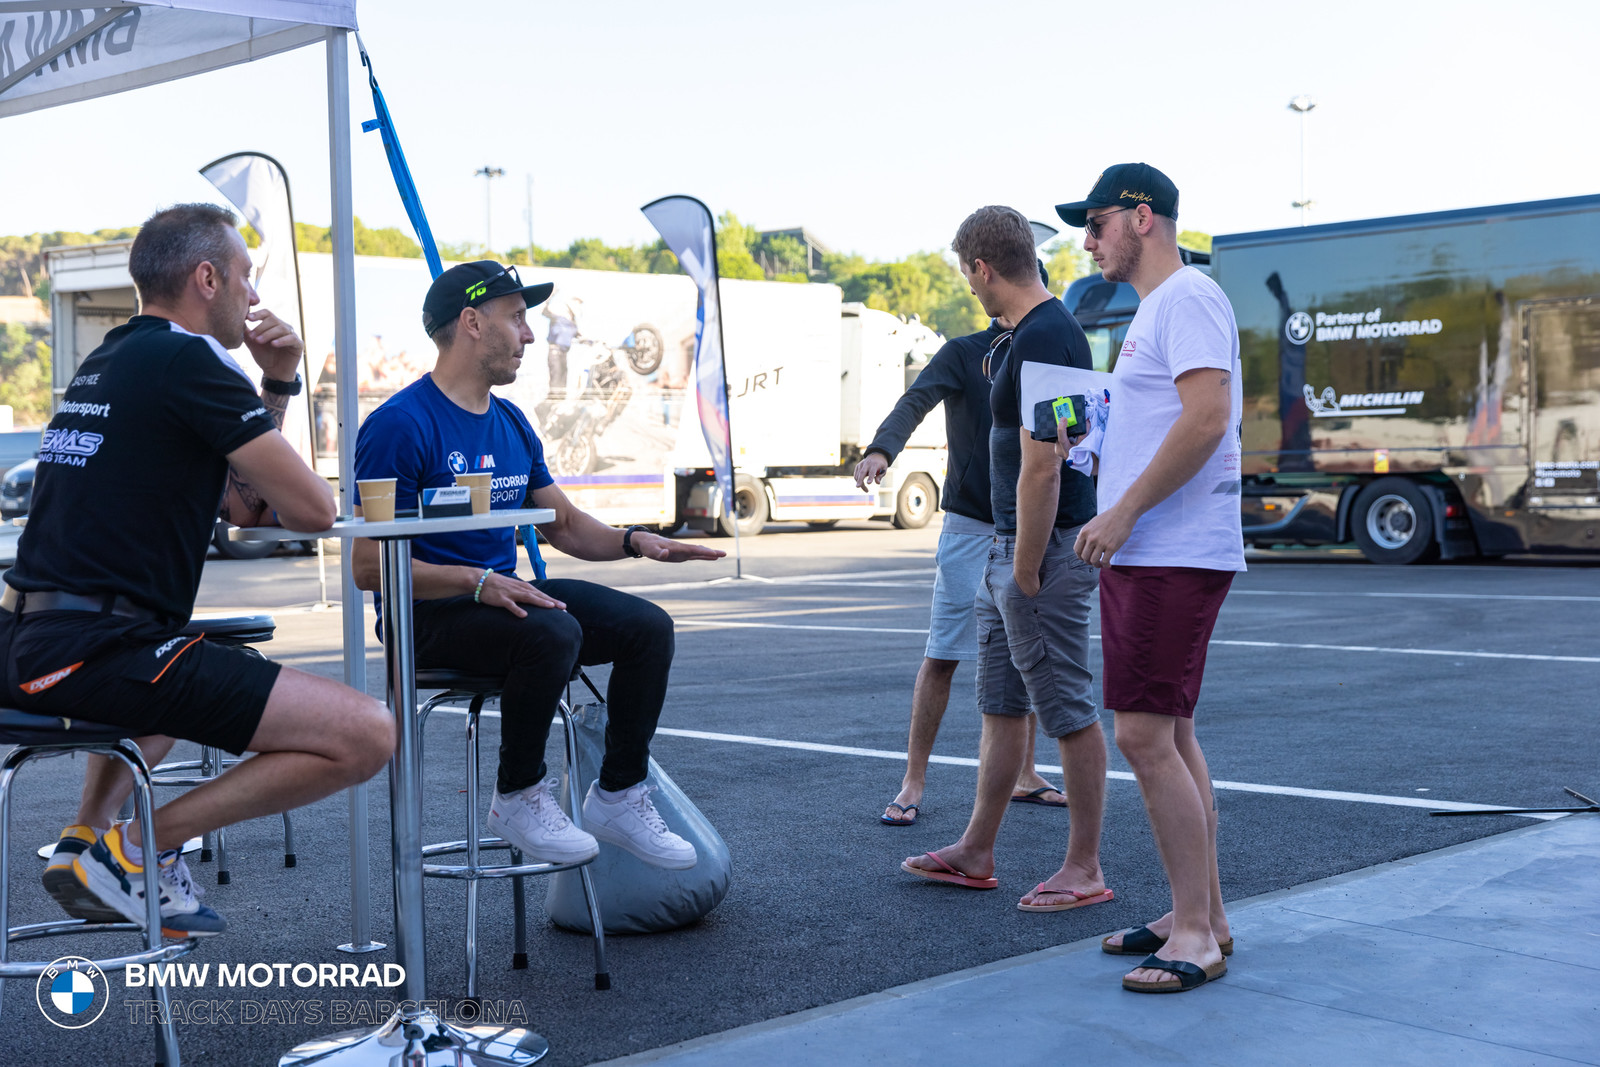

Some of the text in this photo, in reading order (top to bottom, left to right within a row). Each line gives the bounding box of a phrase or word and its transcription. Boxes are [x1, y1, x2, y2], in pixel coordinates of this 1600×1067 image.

[1316, 307, 1382, 326] Partner of
[1316, 325, 1354, 342] BMW
[1356, 319, 1443, 339] MOTORRAD
[728, 366, 784, 399] JRT
[1340, 391, 1425, 408] MICHELIN
[53, 453, 87, 468] TEAM
[490, 474, 529, 490] OTORRAD
[29, 668, 71, 691] IXON
